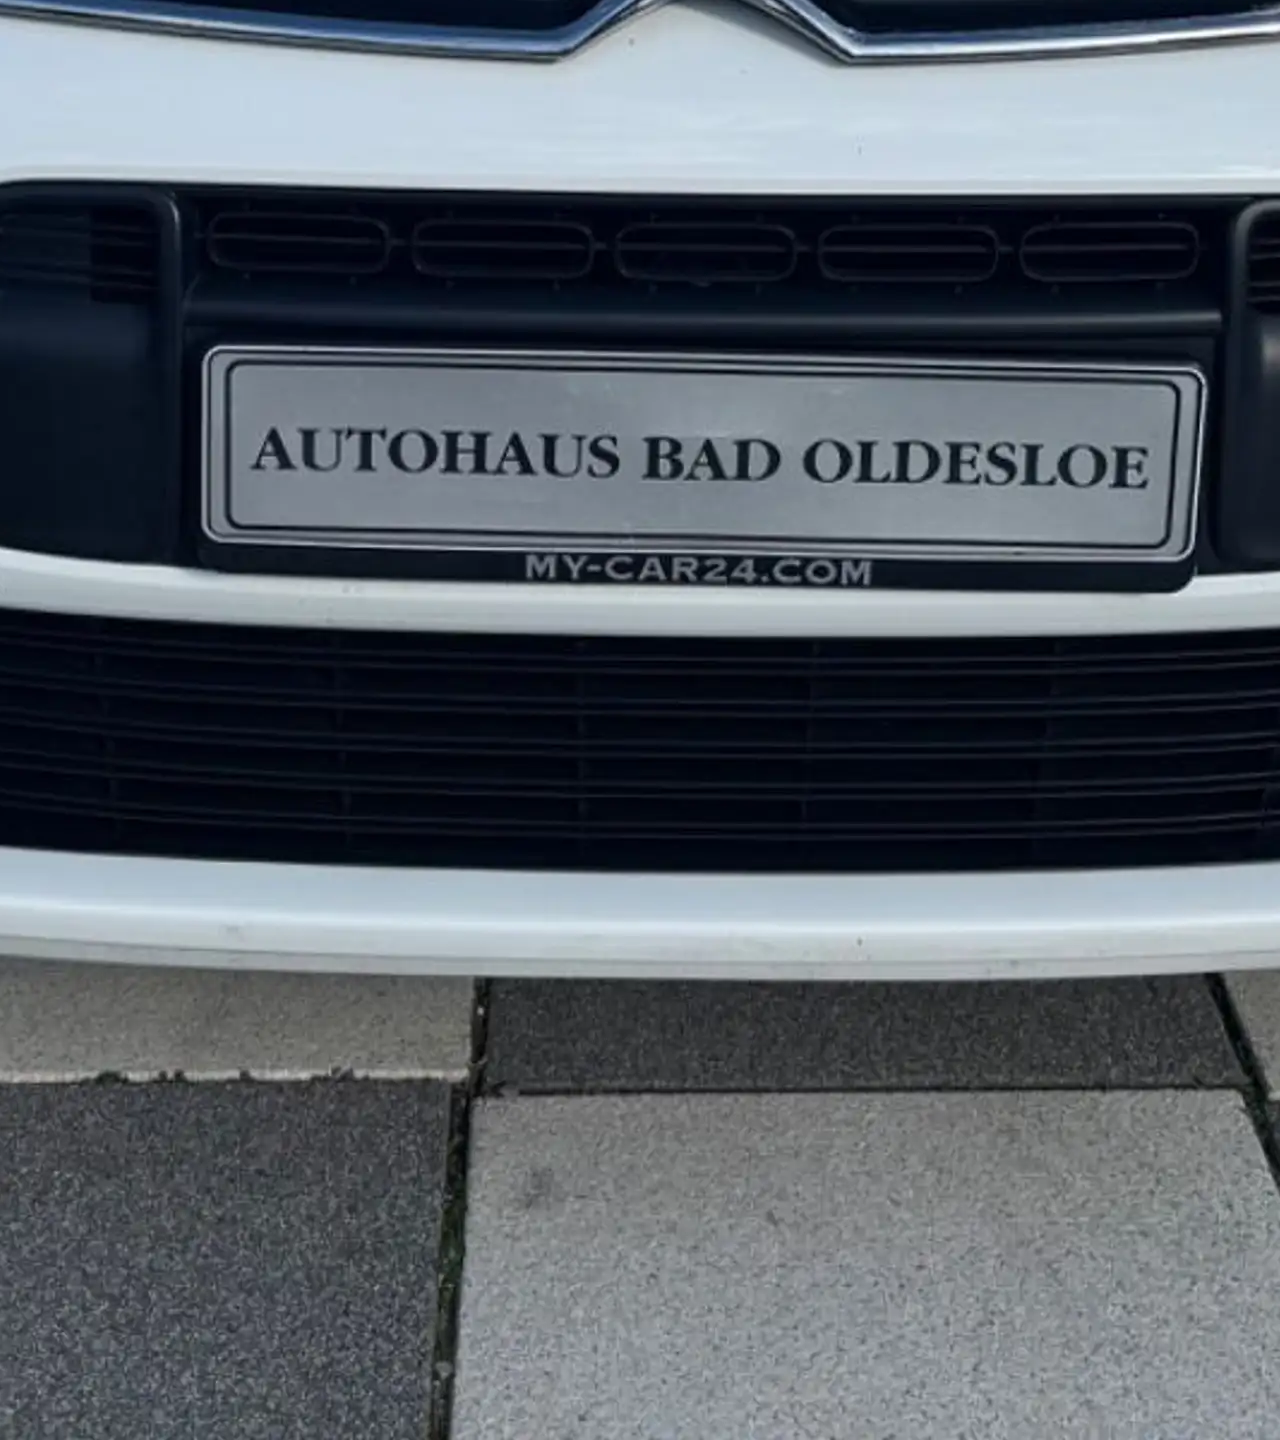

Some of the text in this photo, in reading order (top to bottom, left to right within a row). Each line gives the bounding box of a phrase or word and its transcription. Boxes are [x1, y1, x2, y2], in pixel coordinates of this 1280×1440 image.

[250, 426, 1150, 490] AUTOHAUS BAD OLDESLOE
[524, 554, 871, 586] MY-CAR24.COM
